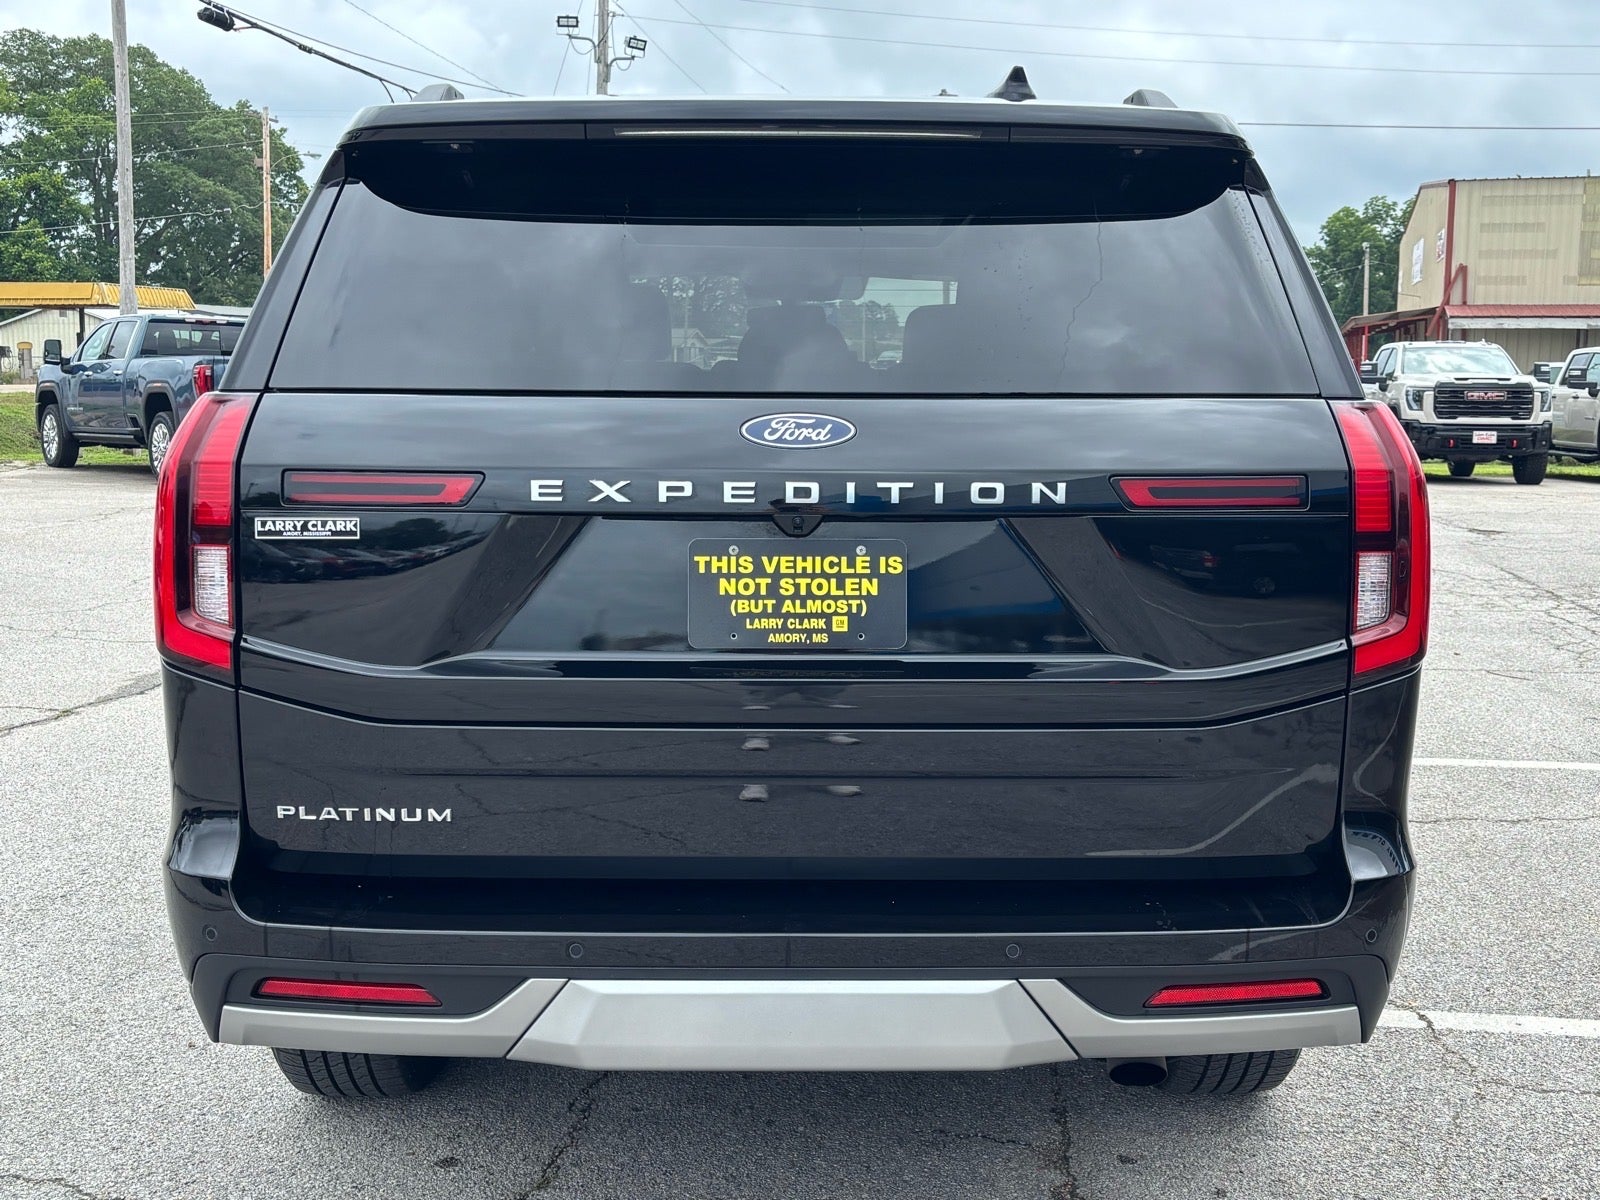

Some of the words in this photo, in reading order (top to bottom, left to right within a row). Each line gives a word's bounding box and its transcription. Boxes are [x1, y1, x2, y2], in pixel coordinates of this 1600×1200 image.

[1467, 392, 1505, 400] GMC
[763, 417, 833, 441] Ford
[530, 479, 1067, 504] EXPEDITION
[257, 520, 304, 531] LARRY
[307, 520, 357, 531] CLARK
[693, 555, 754, 574] THIS
[761, 555, 871, 574] VEHICLE
[879, 555, 904, 574] IS
[719, 577, 772, 596] NOT
[779, 577, 878, 596] STOLEN
[730, 599, 776, 617] (BUT
[781, 599, 867, 617] ALMOST)
[745, 618, 784, 629] LARRY
[787, 618, 827, 629] CLARK
[767, 633, 810, 644] AMORY,
[812, 633, 828, 643] MS
[276, 805, 453, 822] PLATINUM
